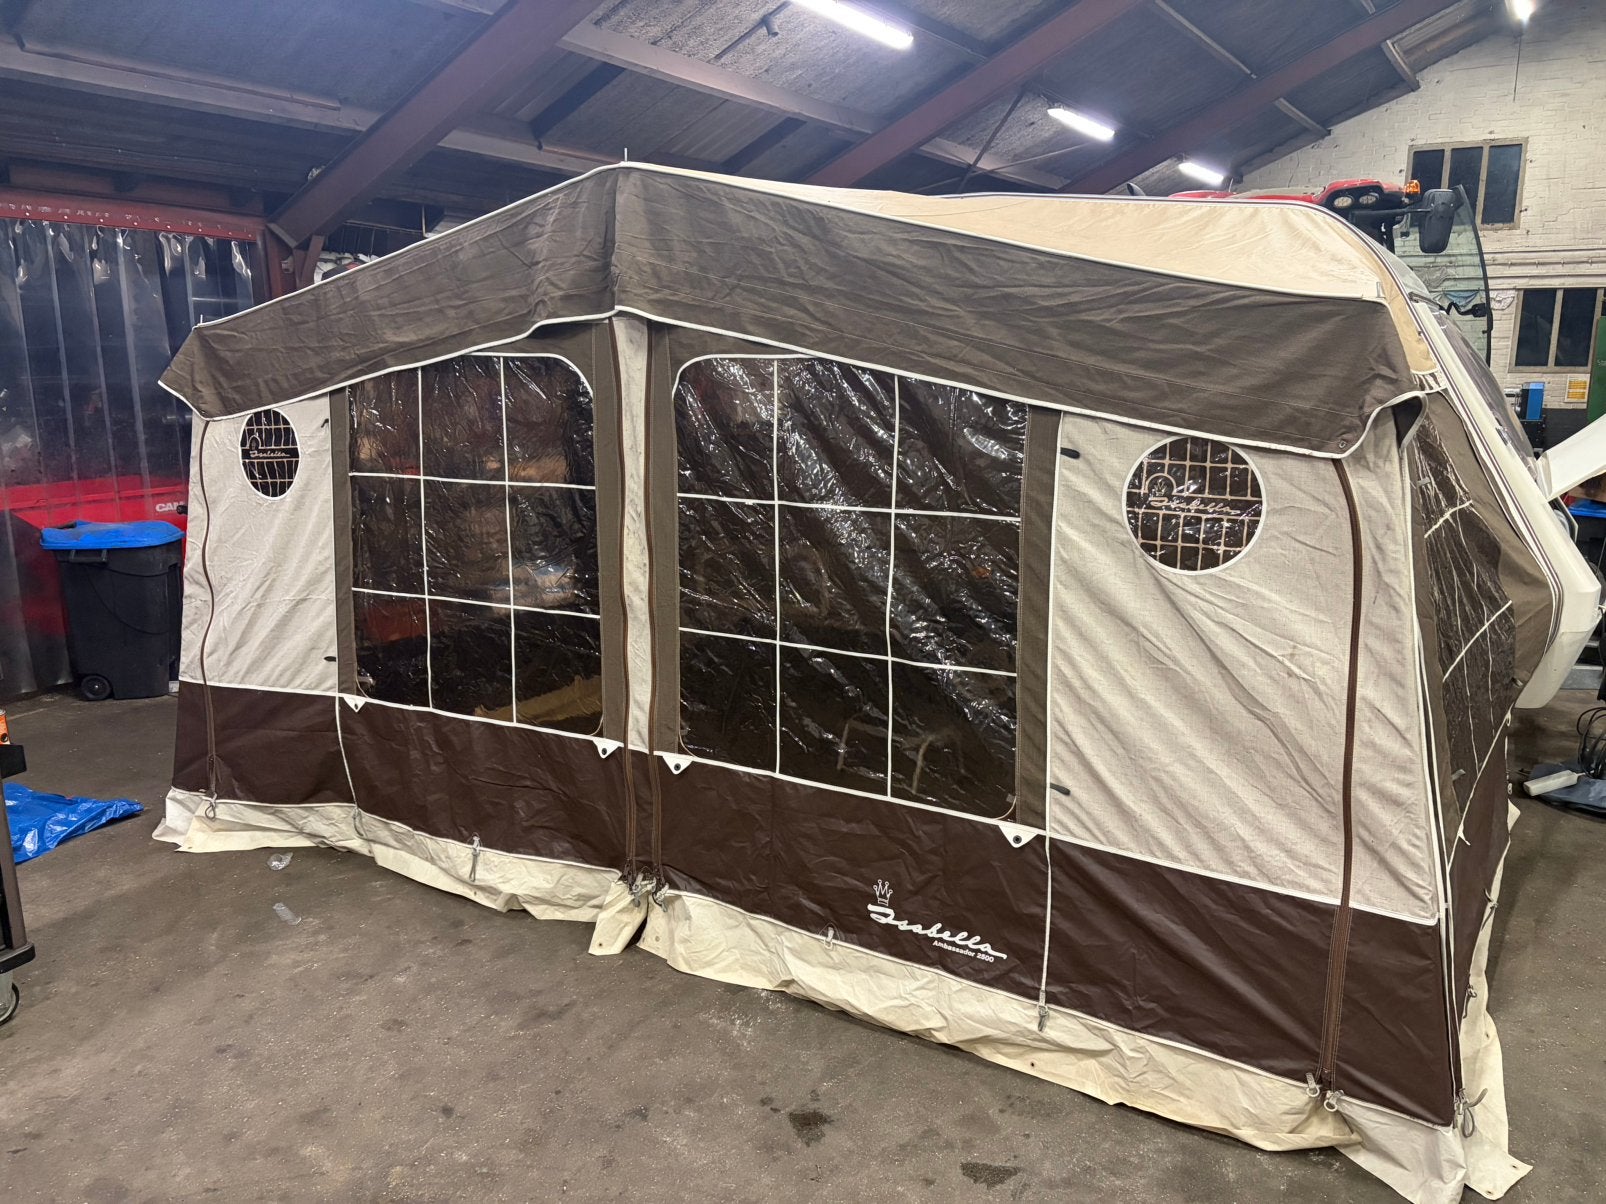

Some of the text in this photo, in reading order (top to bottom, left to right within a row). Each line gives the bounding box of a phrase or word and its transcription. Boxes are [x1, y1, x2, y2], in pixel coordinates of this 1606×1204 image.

[1148, 496, 1242, 515] Isabella
[867, 903, 1008, 960] Isabella
[932, 940, 995, 963] Ambassador 2500
